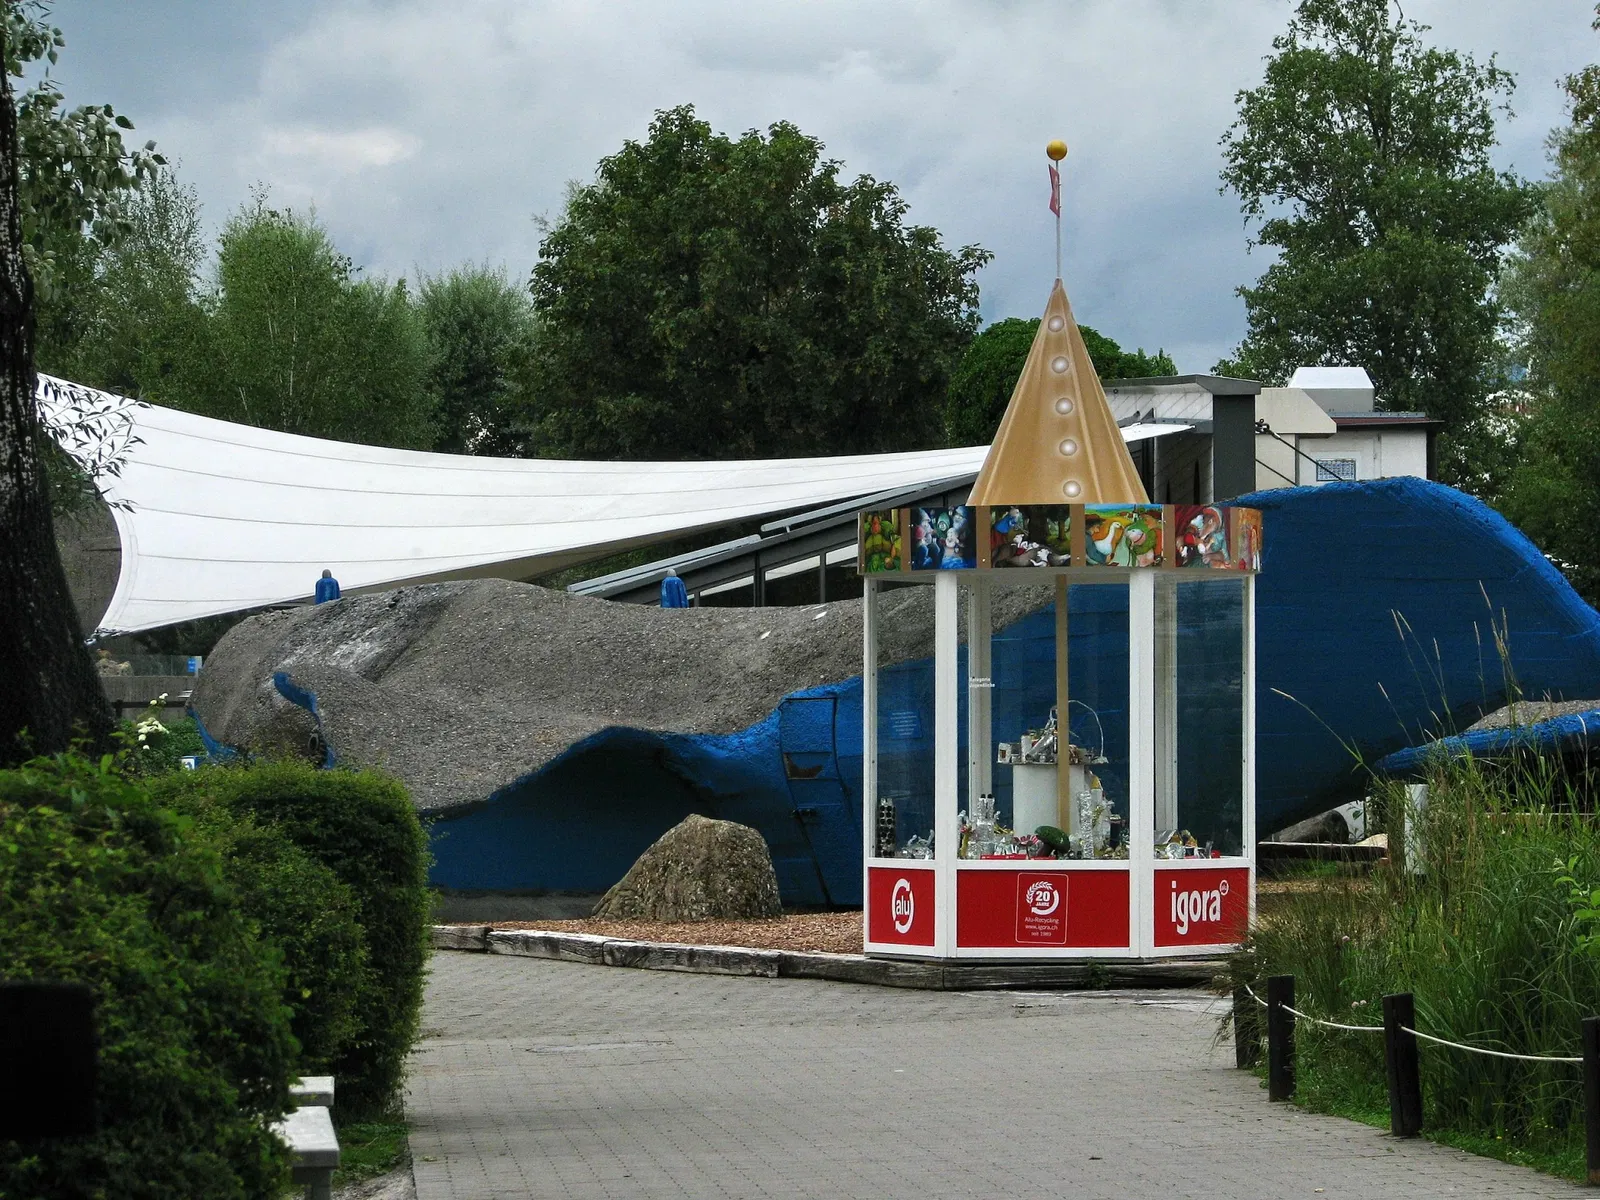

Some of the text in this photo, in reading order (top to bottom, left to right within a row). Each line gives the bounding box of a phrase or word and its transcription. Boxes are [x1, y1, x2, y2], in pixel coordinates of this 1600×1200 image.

[895, 895, 911, 916] alu
[1036, 891, 1050, 901] 20
[1171, 880, 1221, 935] igora
